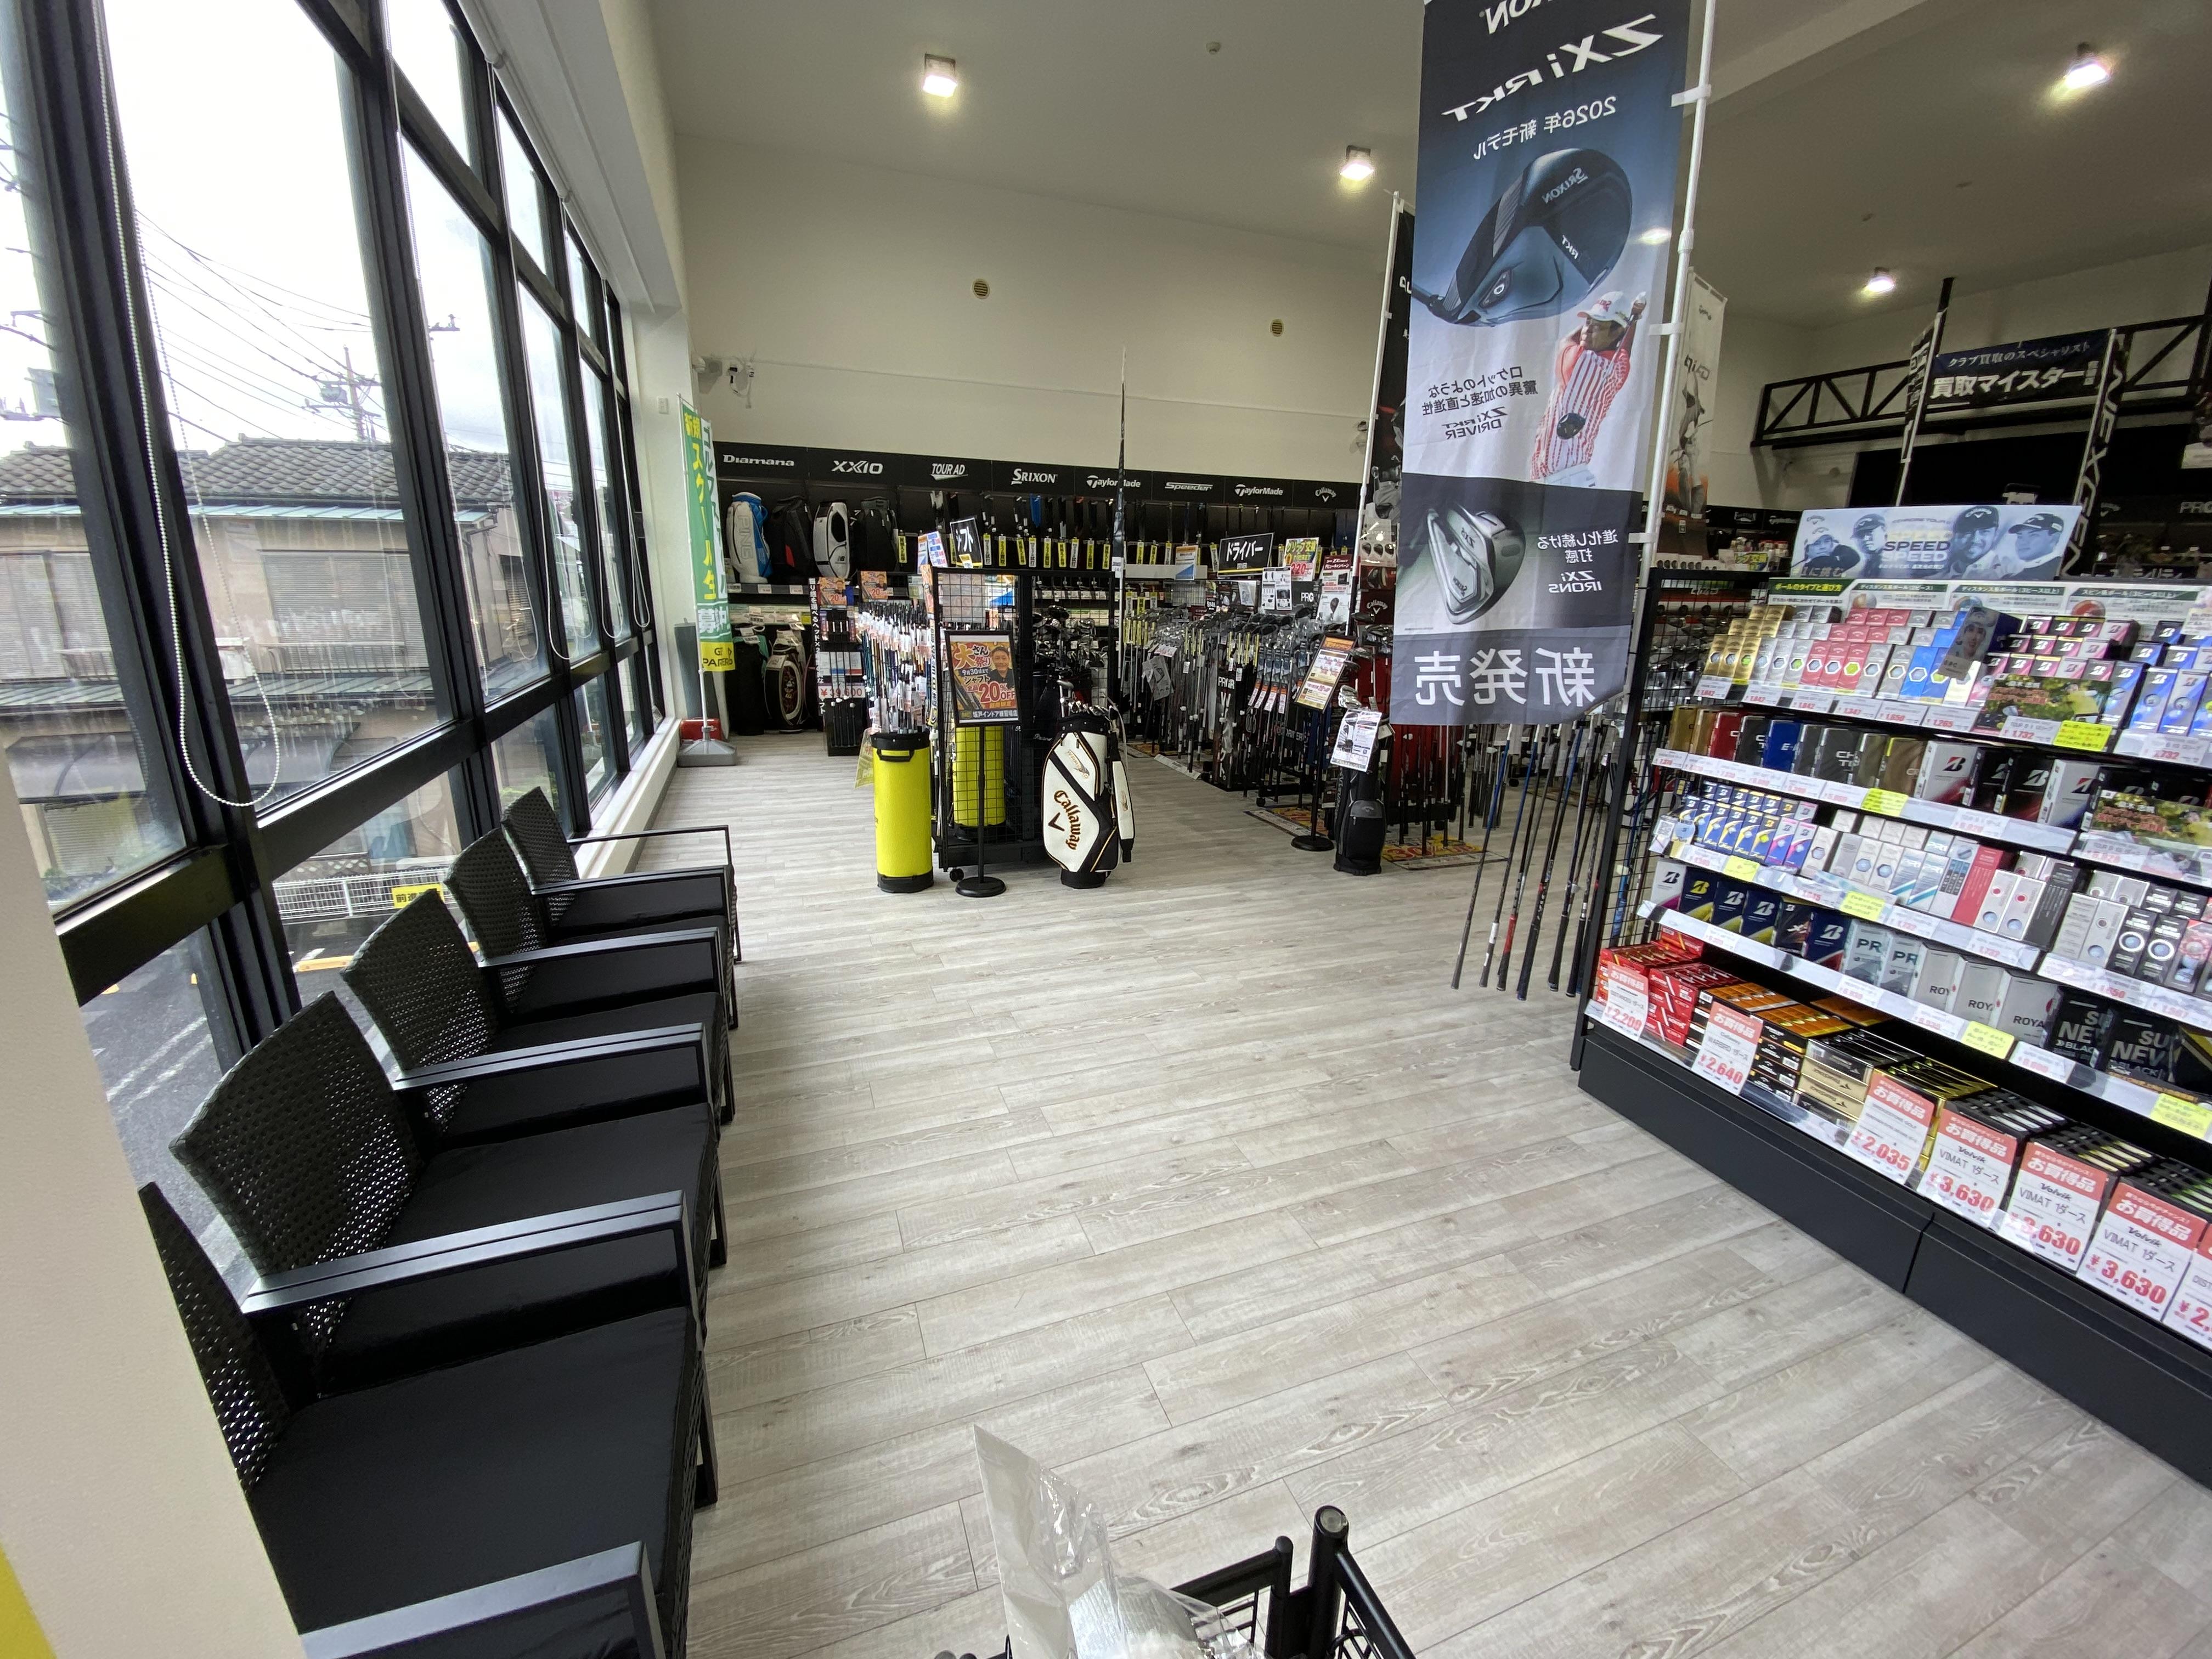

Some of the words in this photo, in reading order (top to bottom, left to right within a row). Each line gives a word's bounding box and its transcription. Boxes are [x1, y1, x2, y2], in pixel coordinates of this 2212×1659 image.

[723, 454, 795, 467] Diamana
[831, 460, 884, 475] XXIO
[932, 463, 952, 475] TOUR
[953, 464, 966, 476] AD
[1012, 468, 1058, 485] SRIXON
[1164, 481, 1213, 492] Speeder
[1234, 484, 1284, 496] TaylorMade
[1315, 487, 1337, 498] Callaway
[1226, 540, 1264, 562] ドライバー
[1883, 540, 1951, 551] SPEED
[953, 643, 975, 669] 大
[972, 645, 989, 656] さん
[975, 656, 991, 668] 祭り
[964, 675, 991, 685] シャフト
[1001, 691, 1015, 700] OFF
[1053, 789, 1081, 850] Callaway
[1714, 1013, 1756, 1039] お買得品
[1873, 1085, 1927, 1120] お買得品
[1945, 1121, 2008, 1159] お買得品
[1939, 1148, 1969, 1169] VIMAT
[1957, 1146, 1987, 1164] Volvik
[2027, 1156, 2097, 1193] お買得品
[1928, 1172, 1996, 1213] ¥3,630
[2019, 1187, 2053, 1209] VIMAT
[2040, 1182, 2073, 1202] Volvik
[2115, 1198, 2193, 1242] お買得品
[2103, 1228, 2139, 1253] VIMAT
[2128, 1226, 2163, 1248] Volvik
[2090, 1254, 2167, 1305] ¥3,630
